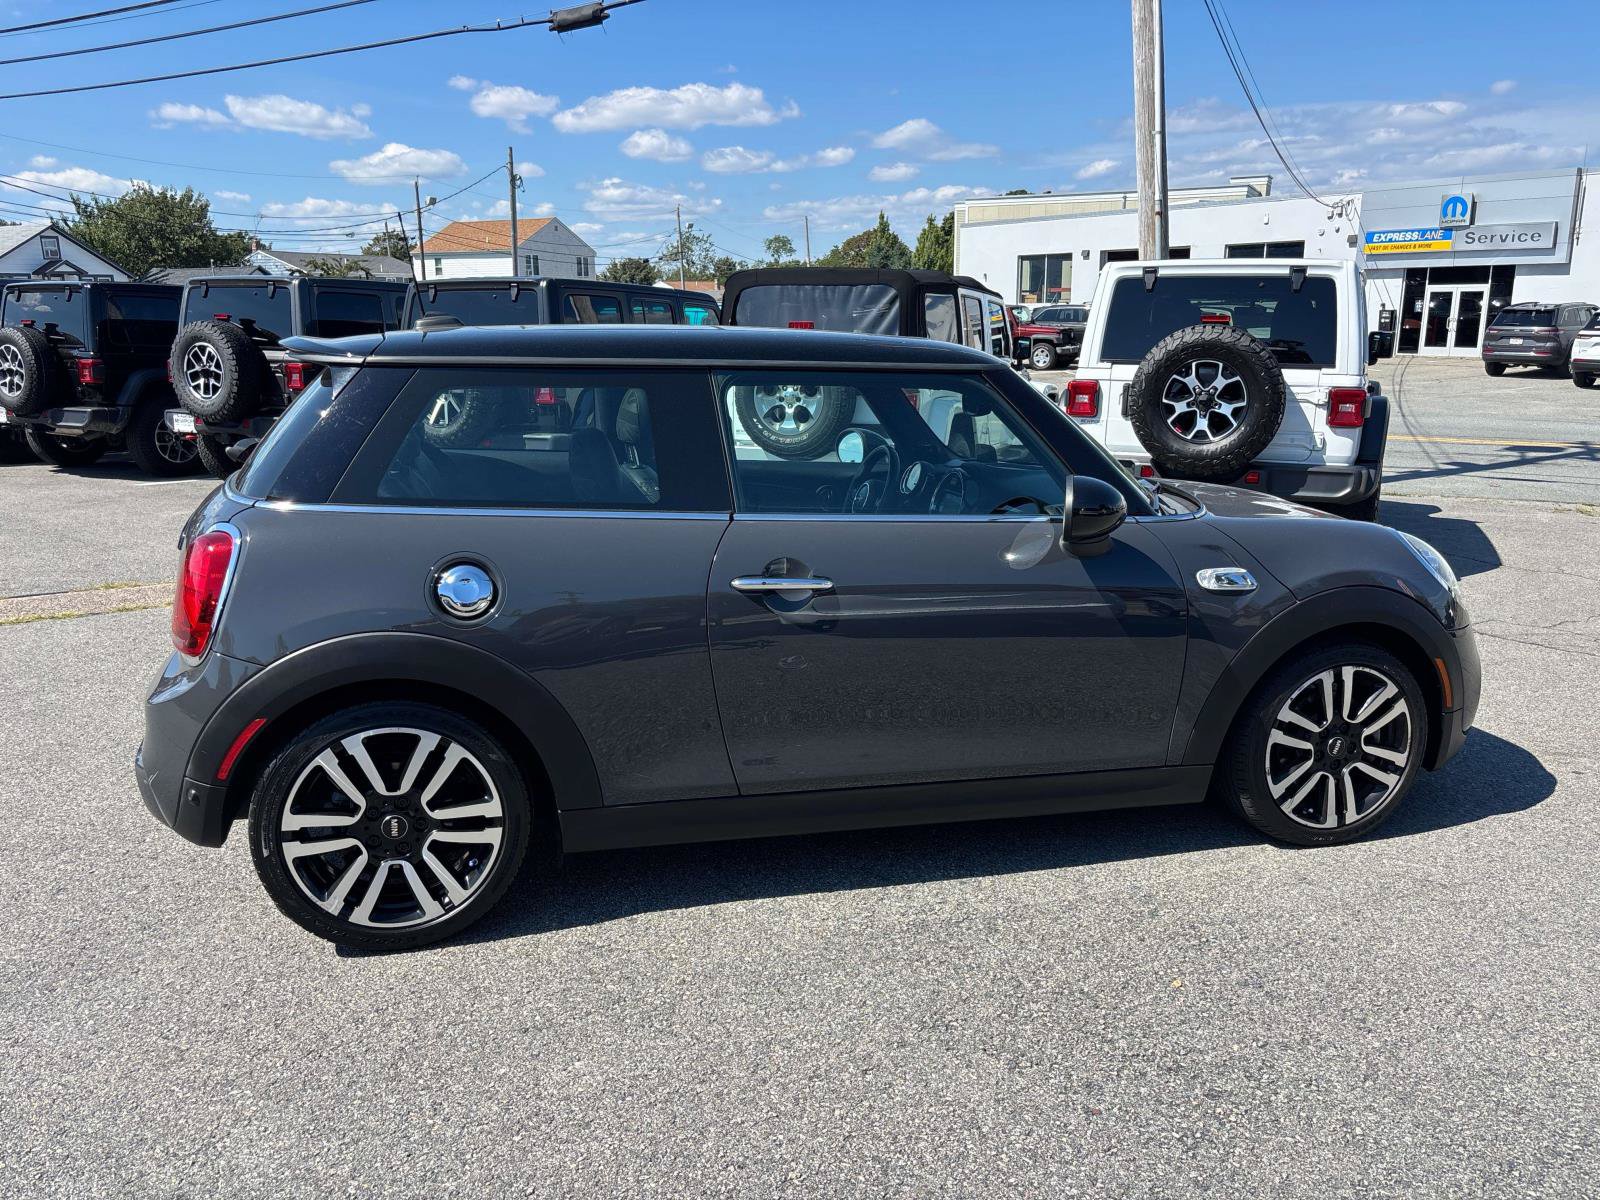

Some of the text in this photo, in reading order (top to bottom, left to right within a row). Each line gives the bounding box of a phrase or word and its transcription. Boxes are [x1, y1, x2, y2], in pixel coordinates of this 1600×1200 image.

[1372, 230, 1445, 242] EXPRESSLANE
[1464, 229, 1542, 245] Service
[390, 818, 399, 837] MINI
